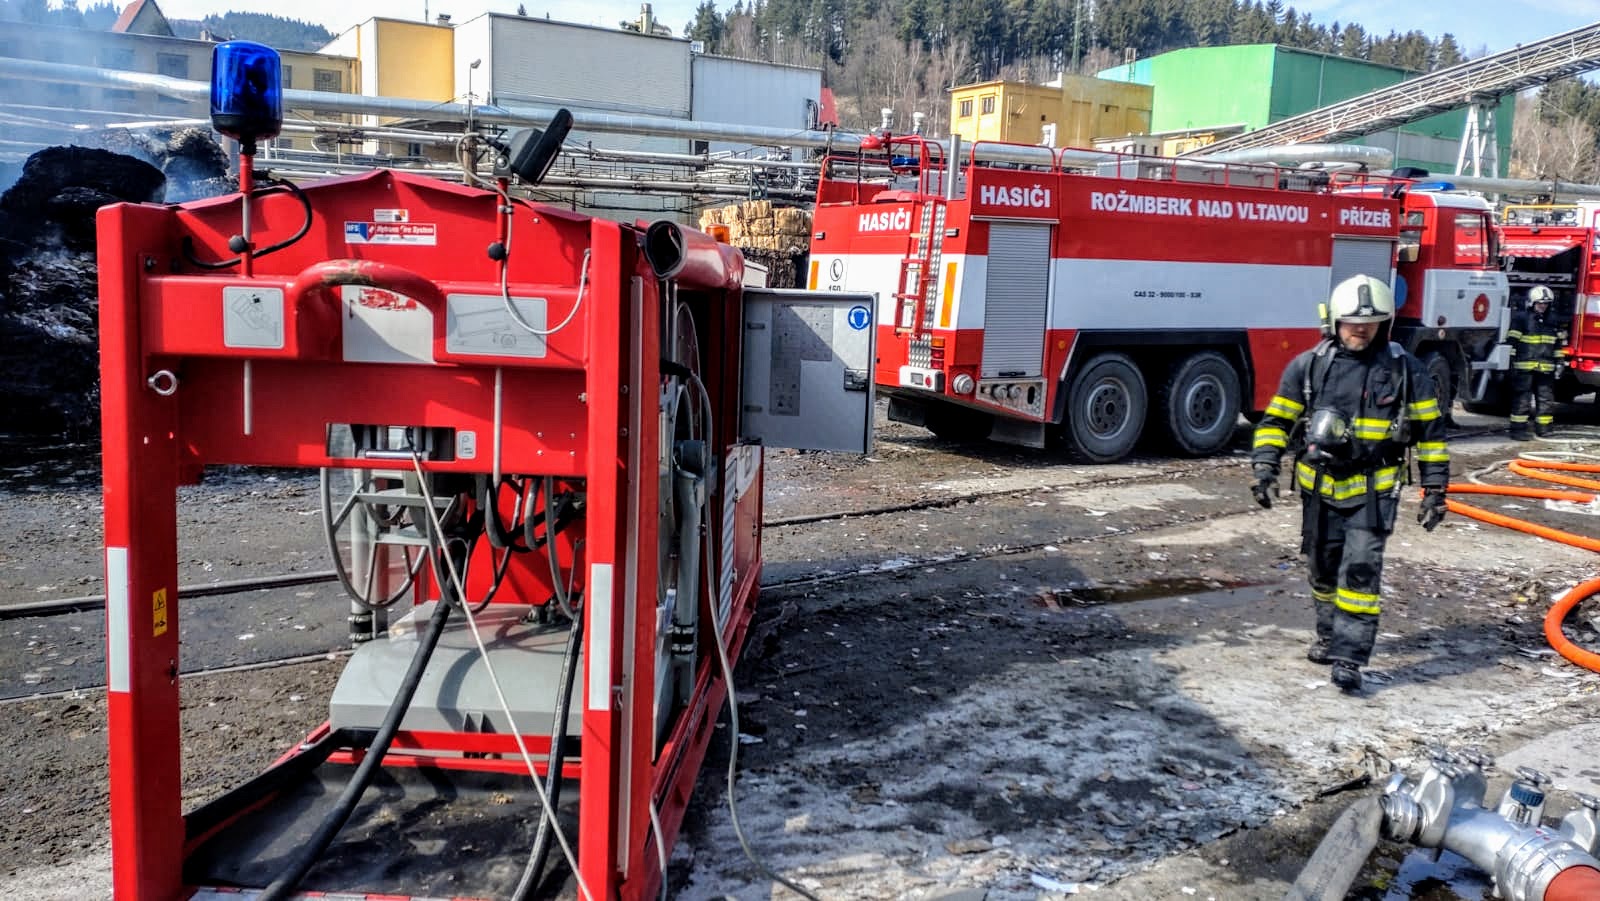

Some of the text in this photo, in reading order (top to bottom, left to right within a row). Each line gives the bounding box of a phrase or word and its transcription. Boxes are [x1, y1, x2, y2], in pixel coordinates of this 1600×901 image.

[981, 185, 1050, 208] HASIČI
[1091, 190, 1192, 216] ROŽMBERK
[1197, 200, 1233, 218] NAD
[1237, 201, 1308, 222] VLTAVOU
[1340, 206, 1391, 227] PŘÍZEŘ
[858, 208, 911, 232] HASIČI
